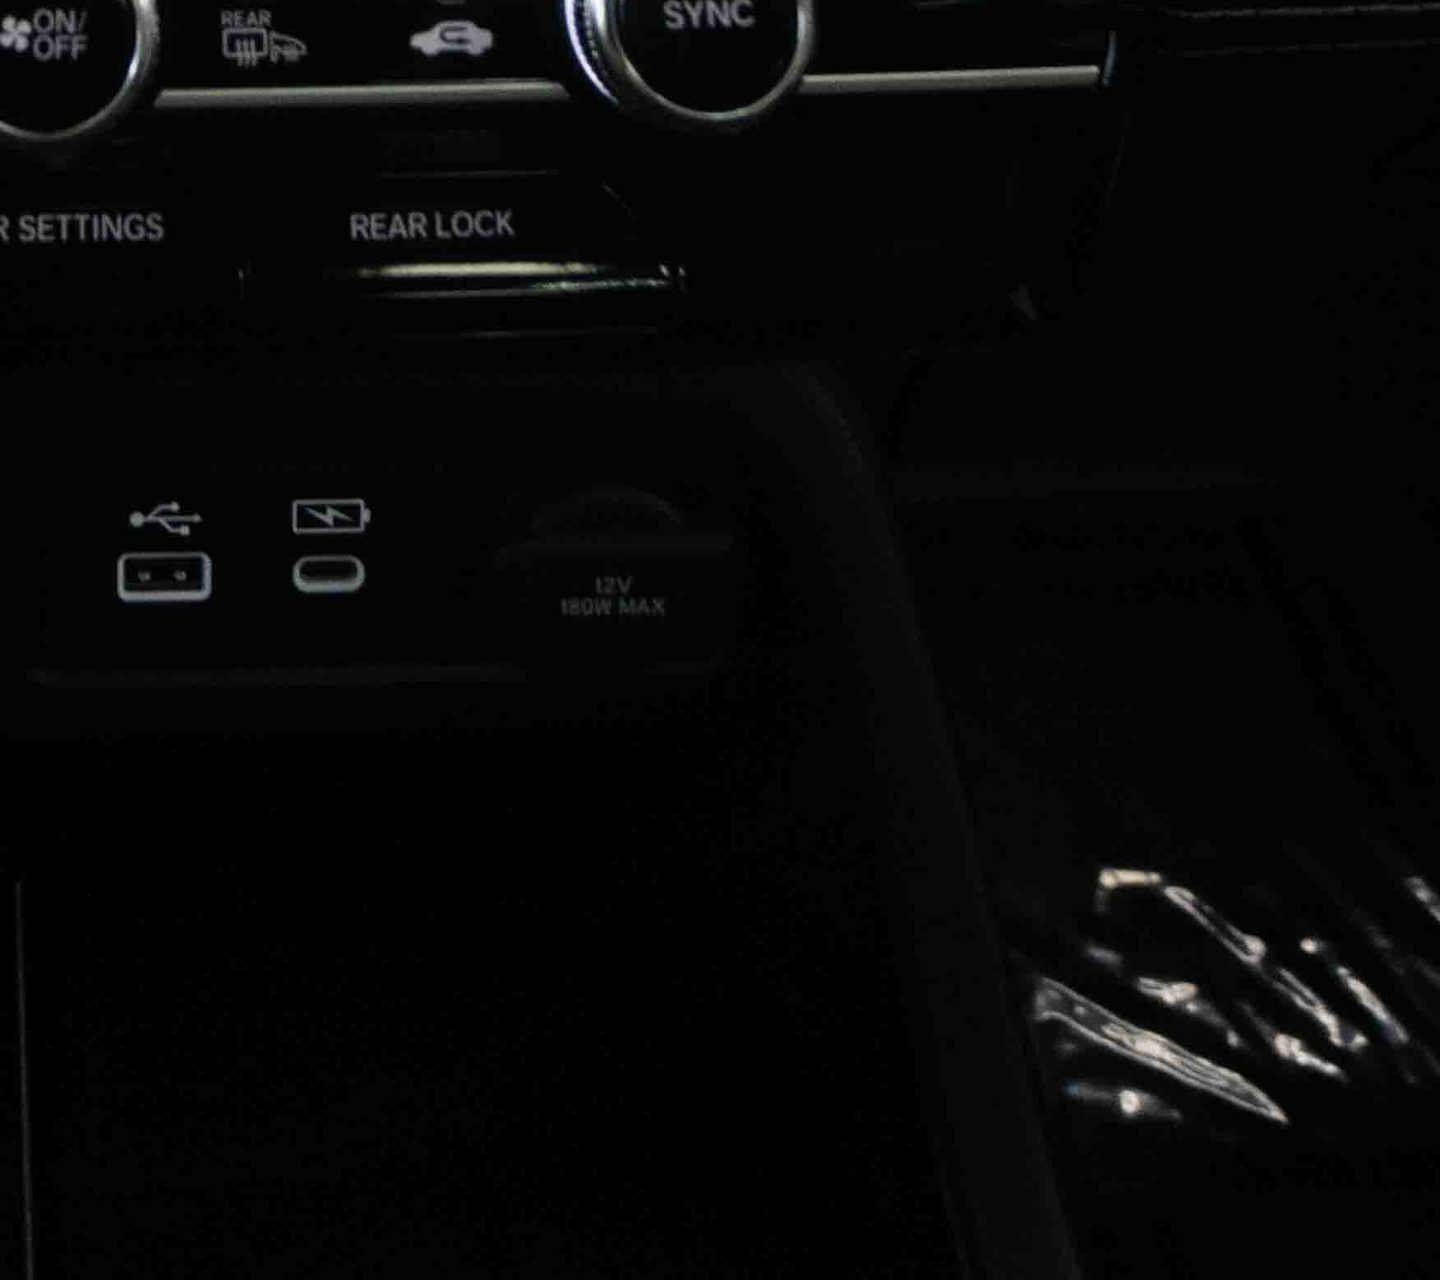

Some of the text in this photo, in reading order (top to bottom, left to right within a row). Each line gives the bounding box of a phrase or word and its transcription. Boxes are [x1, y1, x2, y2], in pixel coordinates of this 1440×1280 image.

[34, 9, 87, 34] ON/
[222, 11, 271, 27] REAR
[34, 36, 87, 60] OFF
[19, 214, 164, 240] SETTINGS
[351, 211, 514, 237] REAR LOCK
[595, 576, 632, 594] 12V
[619, 596, 665, 615] MAX
